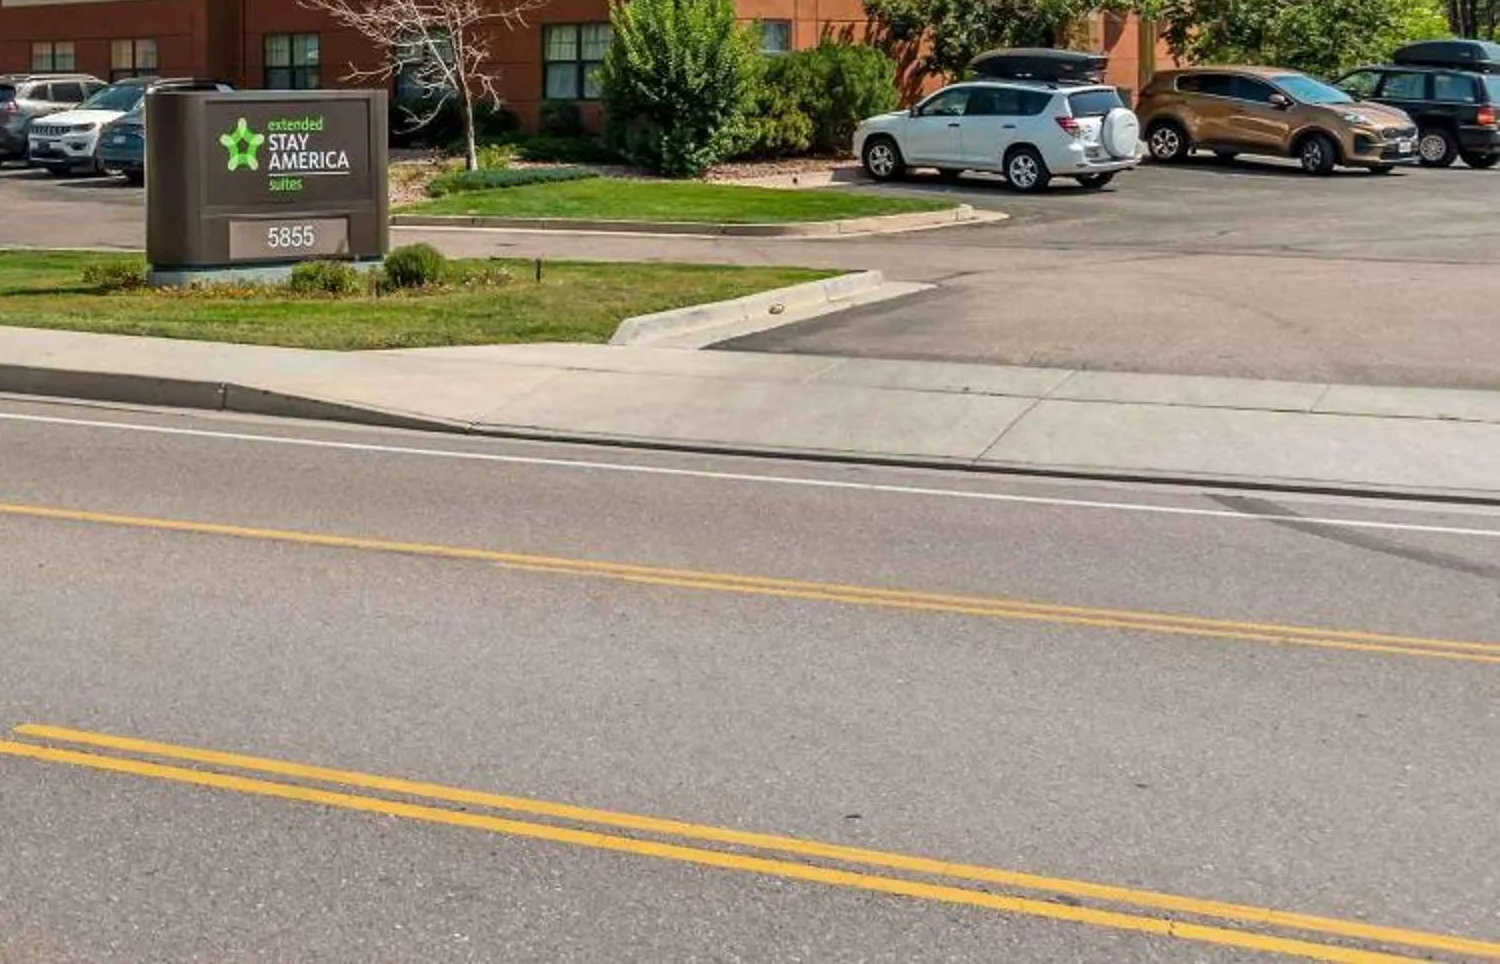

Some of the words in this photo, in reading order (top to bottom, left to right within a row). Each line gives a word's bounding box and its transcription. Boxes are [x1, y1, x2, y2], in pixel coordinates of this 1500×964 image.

[268, 116, 323, 131] extended
[269, 134, 309, 150] STAY
[269, 151, 349, 170] AMERICA
[269, 177, 303, 191] suites
[268, 226, 314, 247] 5855
